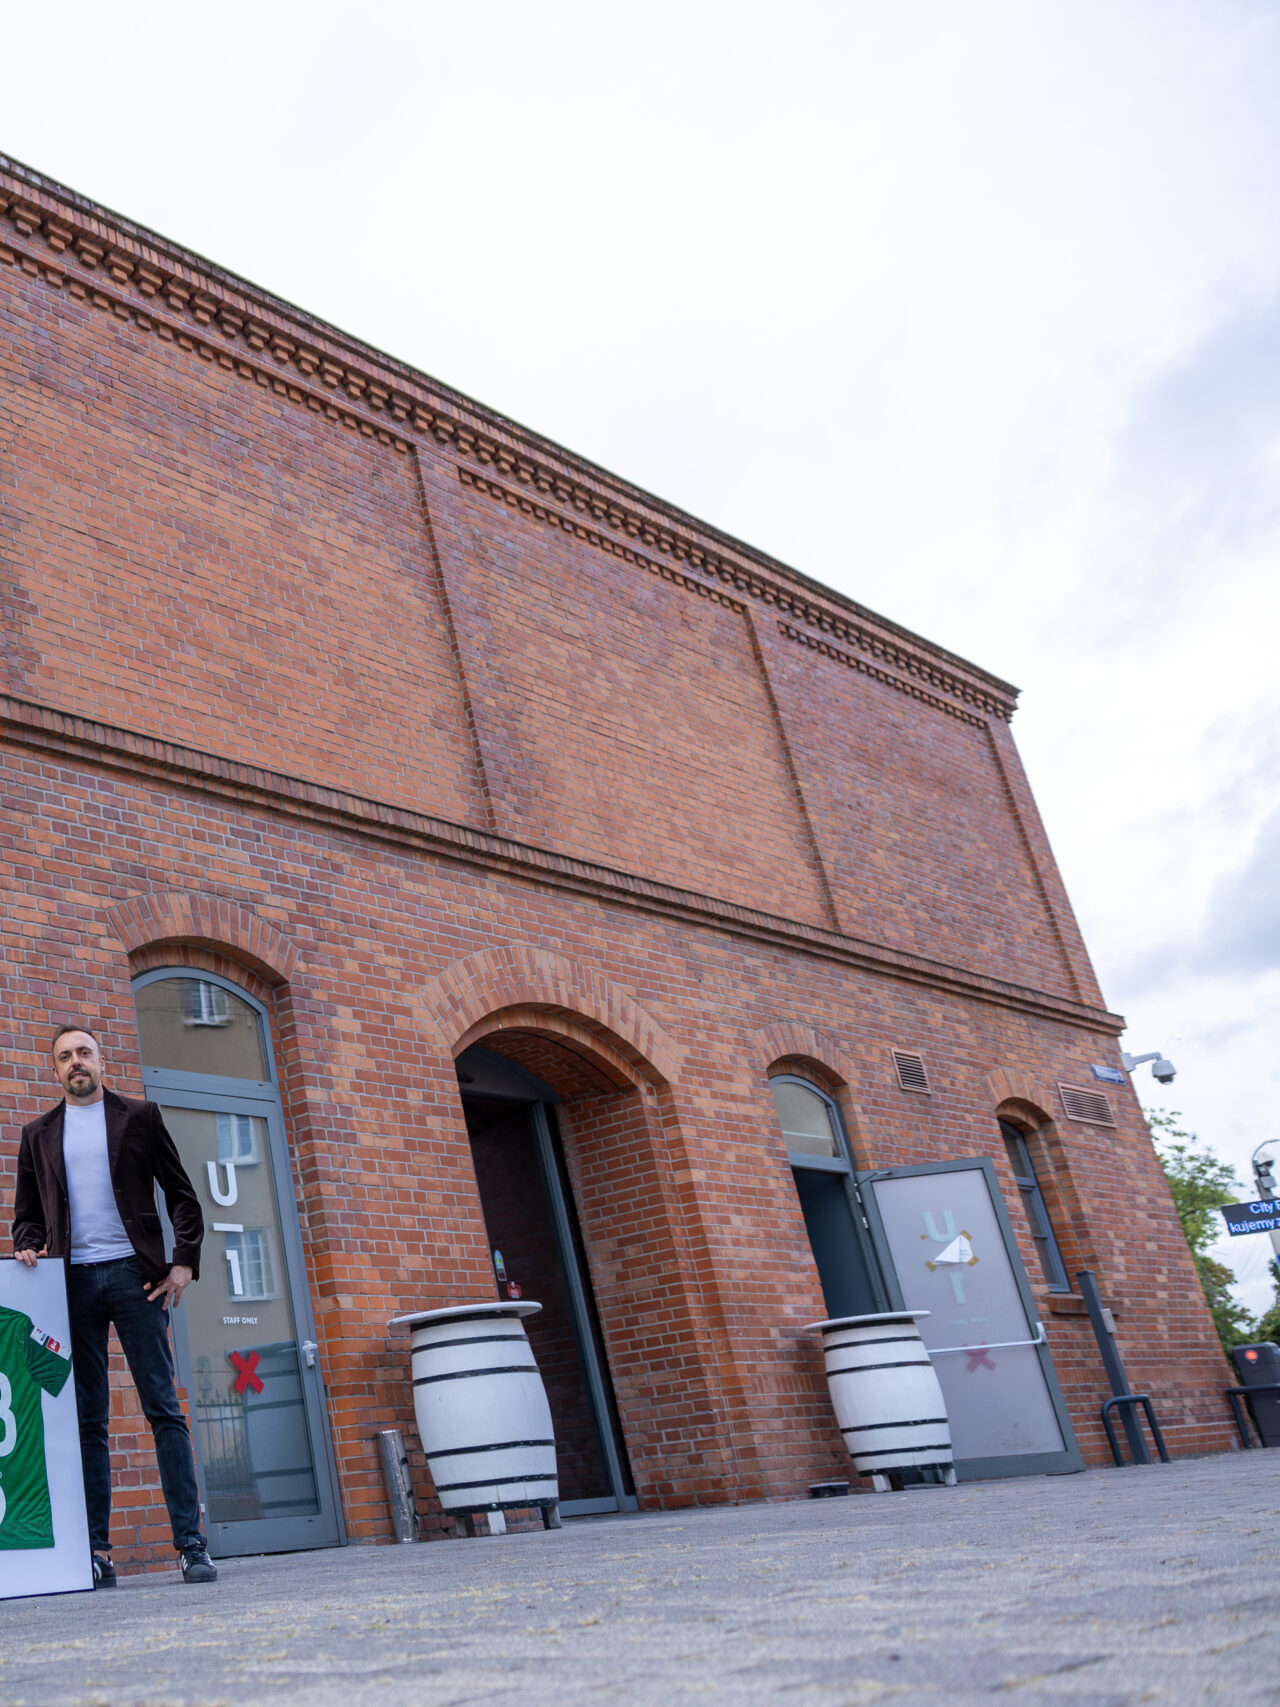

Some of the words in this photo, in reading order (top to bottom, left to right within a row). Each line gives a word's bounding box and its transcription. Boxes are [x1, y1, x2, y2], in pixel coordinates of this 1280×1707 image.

[207, 1161, 238, 1207] U
[222, 1316, 240, 1325] STAFF
[241, 1317, 258, 1325] ONLY
